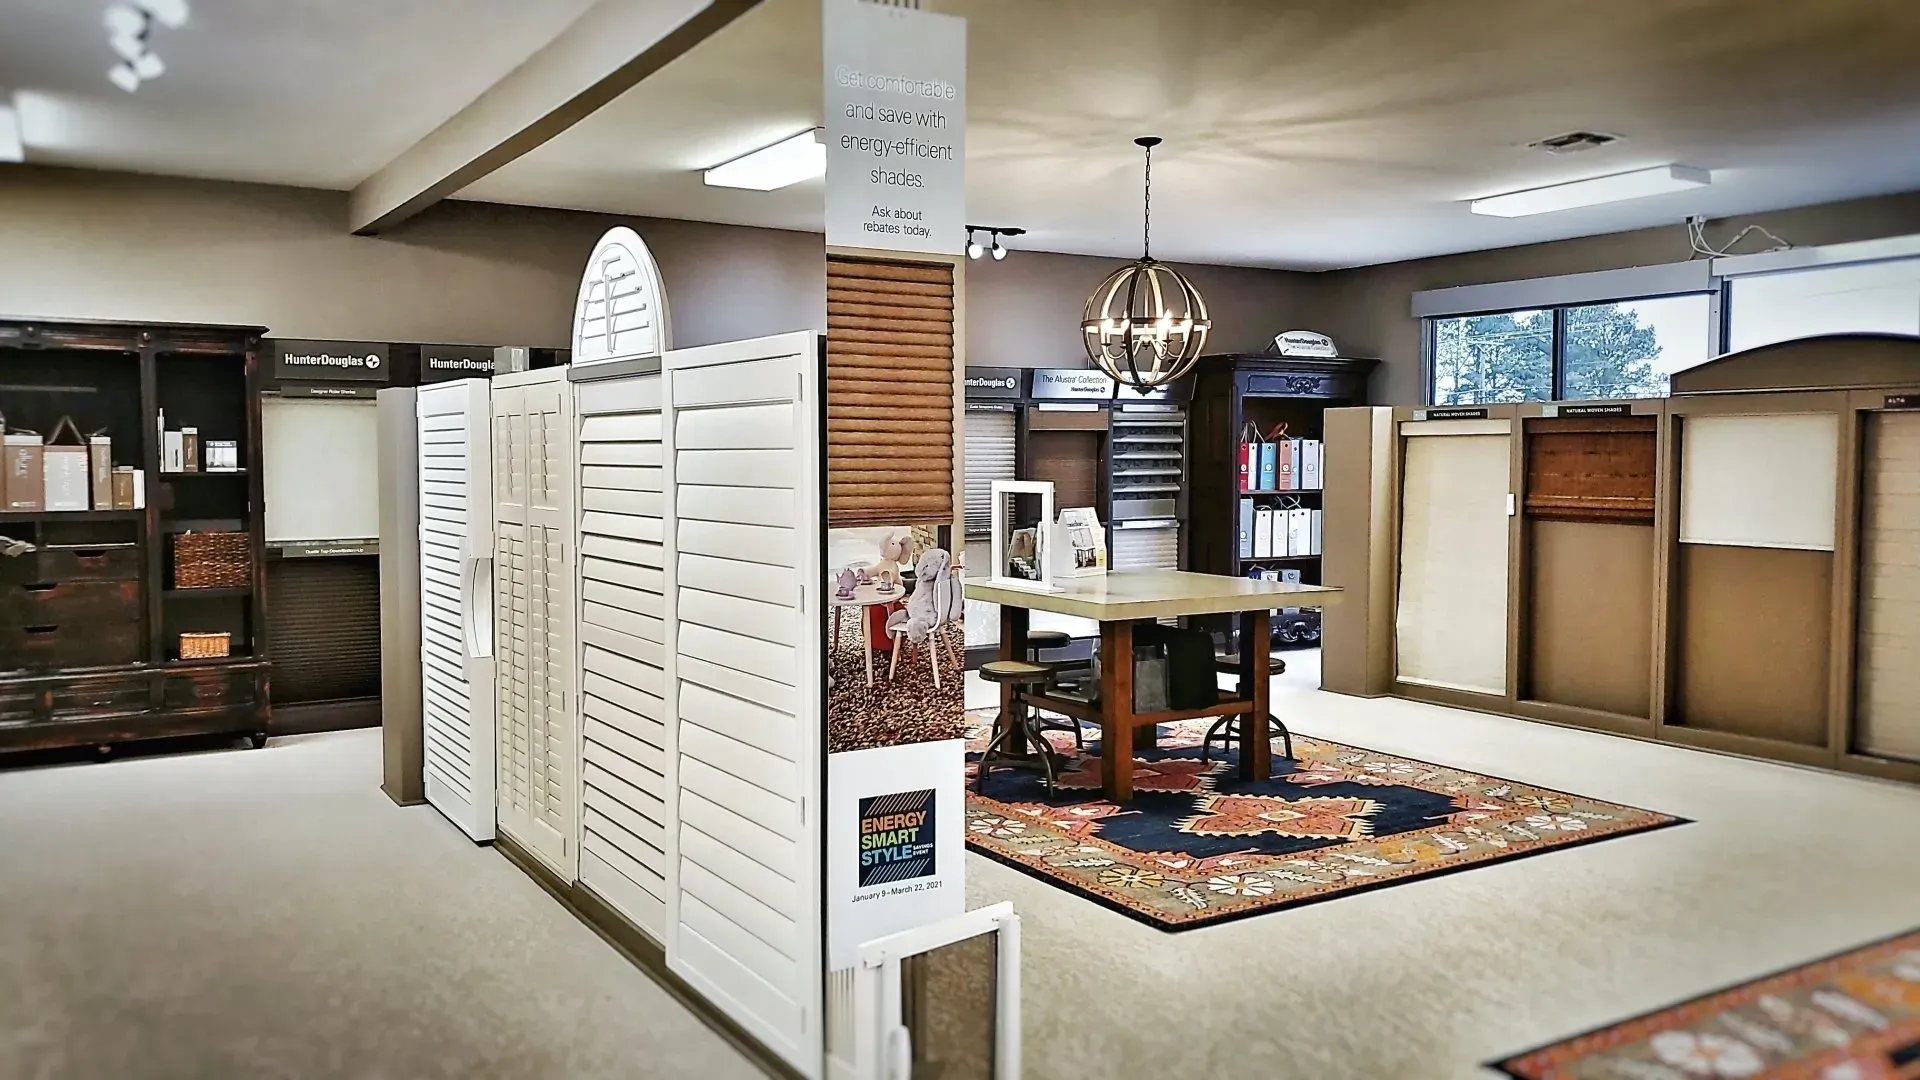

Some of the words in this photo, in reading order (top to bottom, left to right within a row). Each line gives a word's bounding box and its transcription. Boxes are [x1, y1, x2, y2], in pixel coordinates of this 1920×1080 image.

[835, 65, 863, 88] Get
[866, 73, 955, 99] comfortable
[845, 102, 874, 120] and
[878, 108, 912, 125] save
[916, 110, 946, 129] with
[841, 134, 952, 160] energy-efficient
[870, 166, 925, 188] shades.
[872, 205, 891, 218] Ask
[894, 208, 922, 221] about
[863, 221, 900, 234] rebates
[903, 224, 932, 238] today.
[284, 353, 364, 368] HunterDouglas
[429, 358, 495, 371] HunterDougla
[1042, 375, 1054, 383] The
[1078, 376, 1107, 384] Collection
[861, 810, 927, 834] ENERGY
[861, 827, 919, 850] SMART
[861, 844, 913, 866] STYLE
[913, 842, 933, 850] SAVINGS
[852, 892, 880, 902] January
[891, 885, 912, 896] March
[914, 883, 925, 891] 22,
[926, 880, 943, 889] 2021
